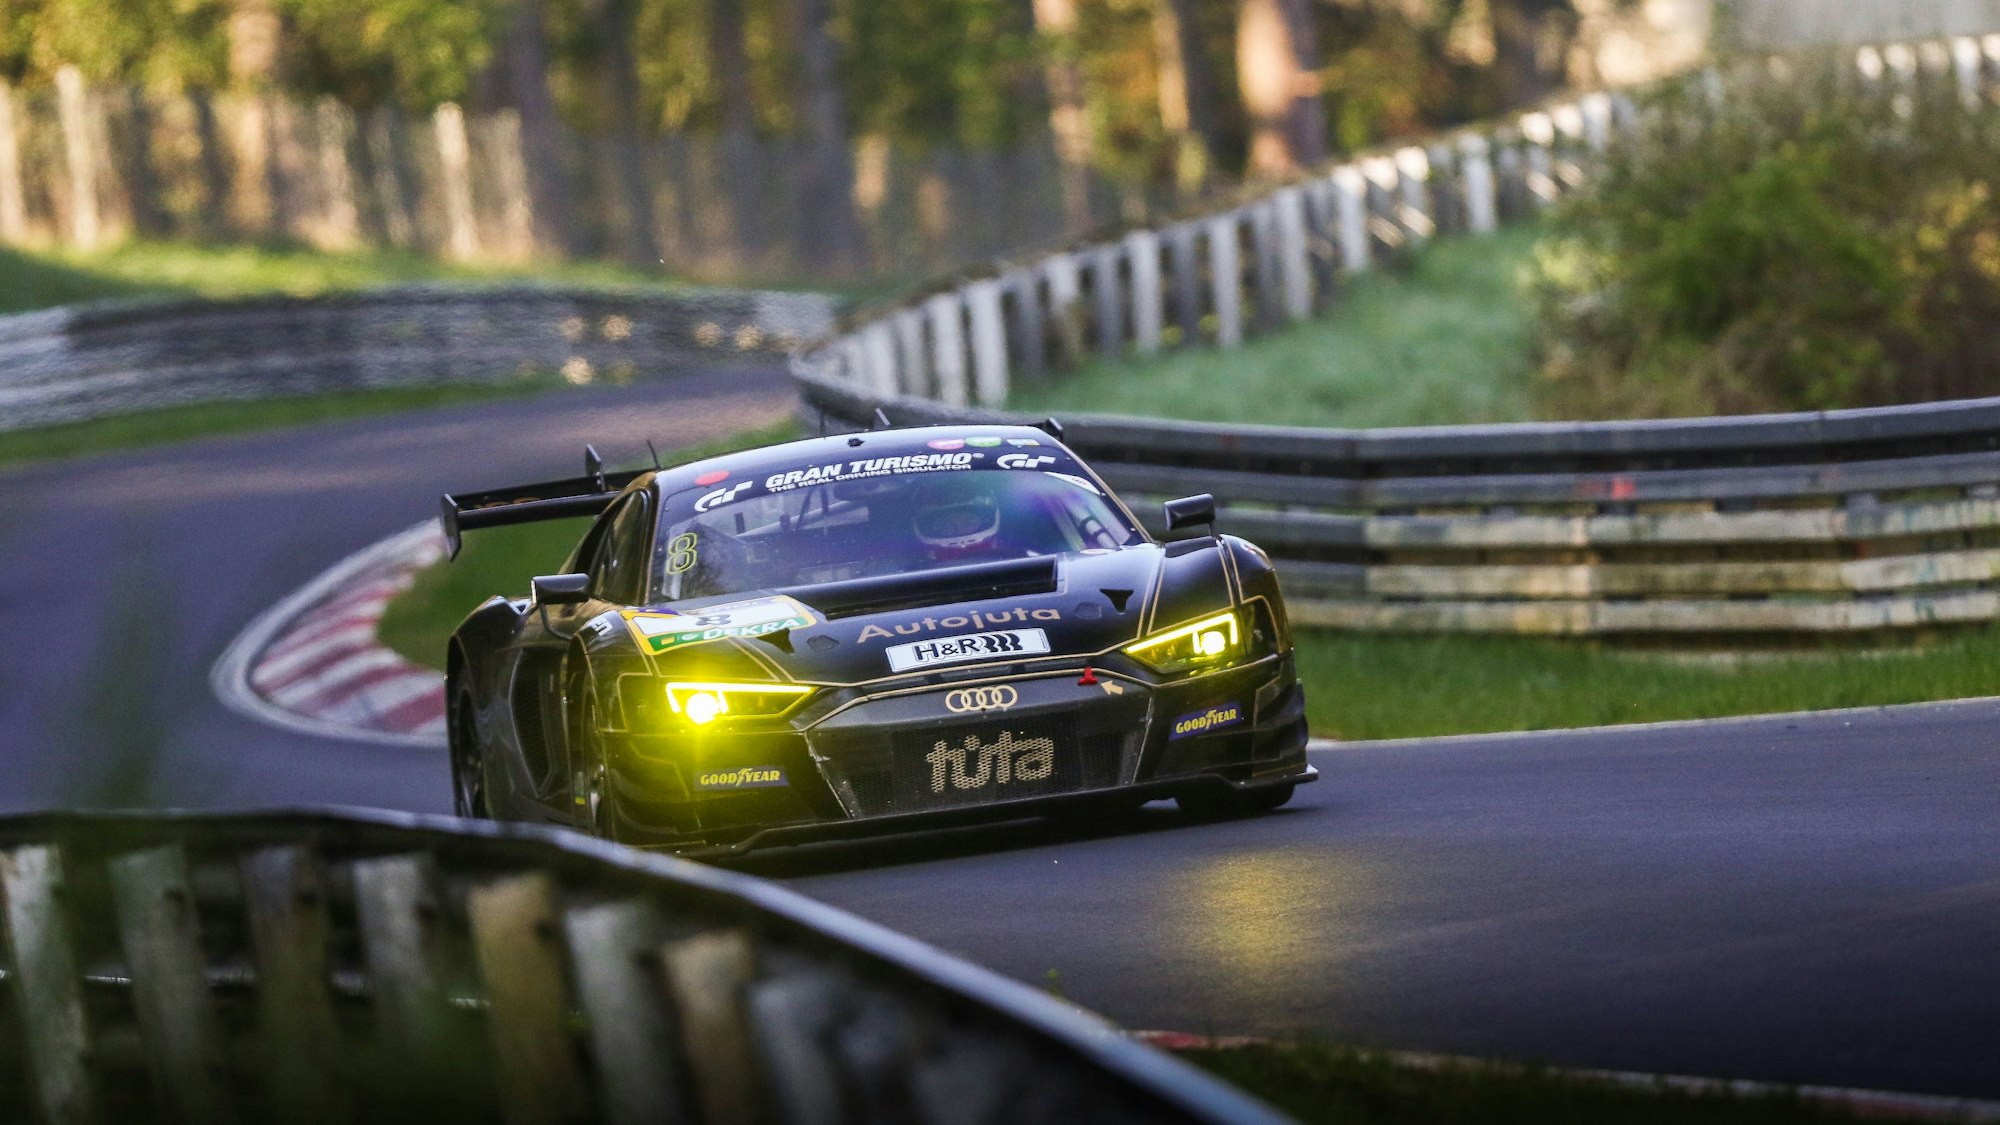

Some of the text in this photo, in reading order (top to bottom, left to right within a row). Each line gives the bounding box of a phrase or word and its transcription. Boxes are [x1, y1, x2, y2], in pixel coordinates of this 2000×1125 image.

[765, 463, 843, 488] GRAN
[768, 464, 972, 493] THE REAL DRIVING SIMULATOR
[665, 532, 698, 575] 8
[696, 614, 731, 626] 8
[703, 619, 800, 640] DEKRA
[857, 607, 1061, 643] Autojuta
[914, 638, 976, 661] H&R
[1176, 709, 1237, 734] GOODYEAR
[701, 768, 780, 787] GOODYEAR
